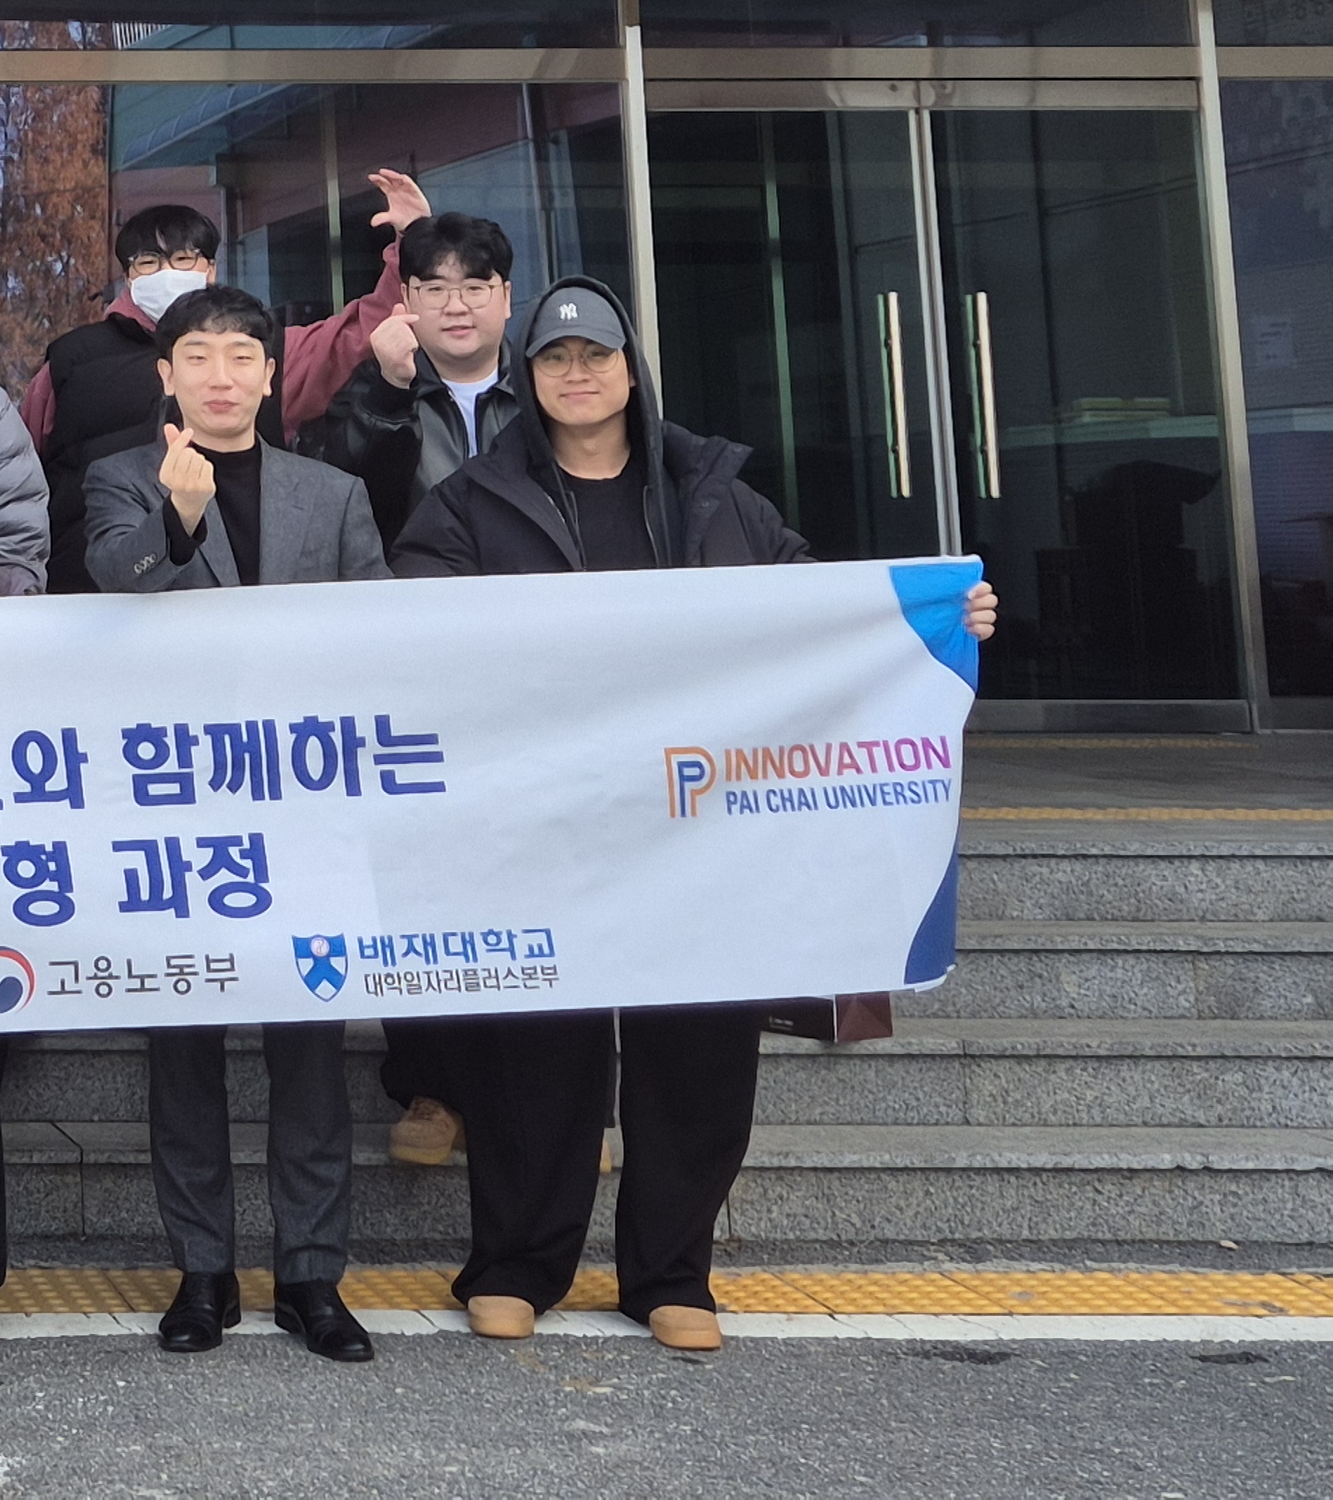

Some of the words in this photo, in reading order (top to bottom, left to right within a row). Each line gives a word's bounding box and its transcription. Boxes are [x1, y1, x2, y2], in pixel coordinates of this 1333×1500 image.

[120, 713, 447, 807] 함께하는
[724, 735, 952, 783] INNOVATION
[725, 790, 760, 816] PAI
[766, 787, 820, 813] CHAI
[823, 778, 953, 810] UNIVERSITY
[110, 831, 273, 919] 과정
[356, 927, 557, 968] 배재대학교
[46, 952, 240, 999] 고용노동부
[363, 963, 560, 998] 대학일자리플러스본부
